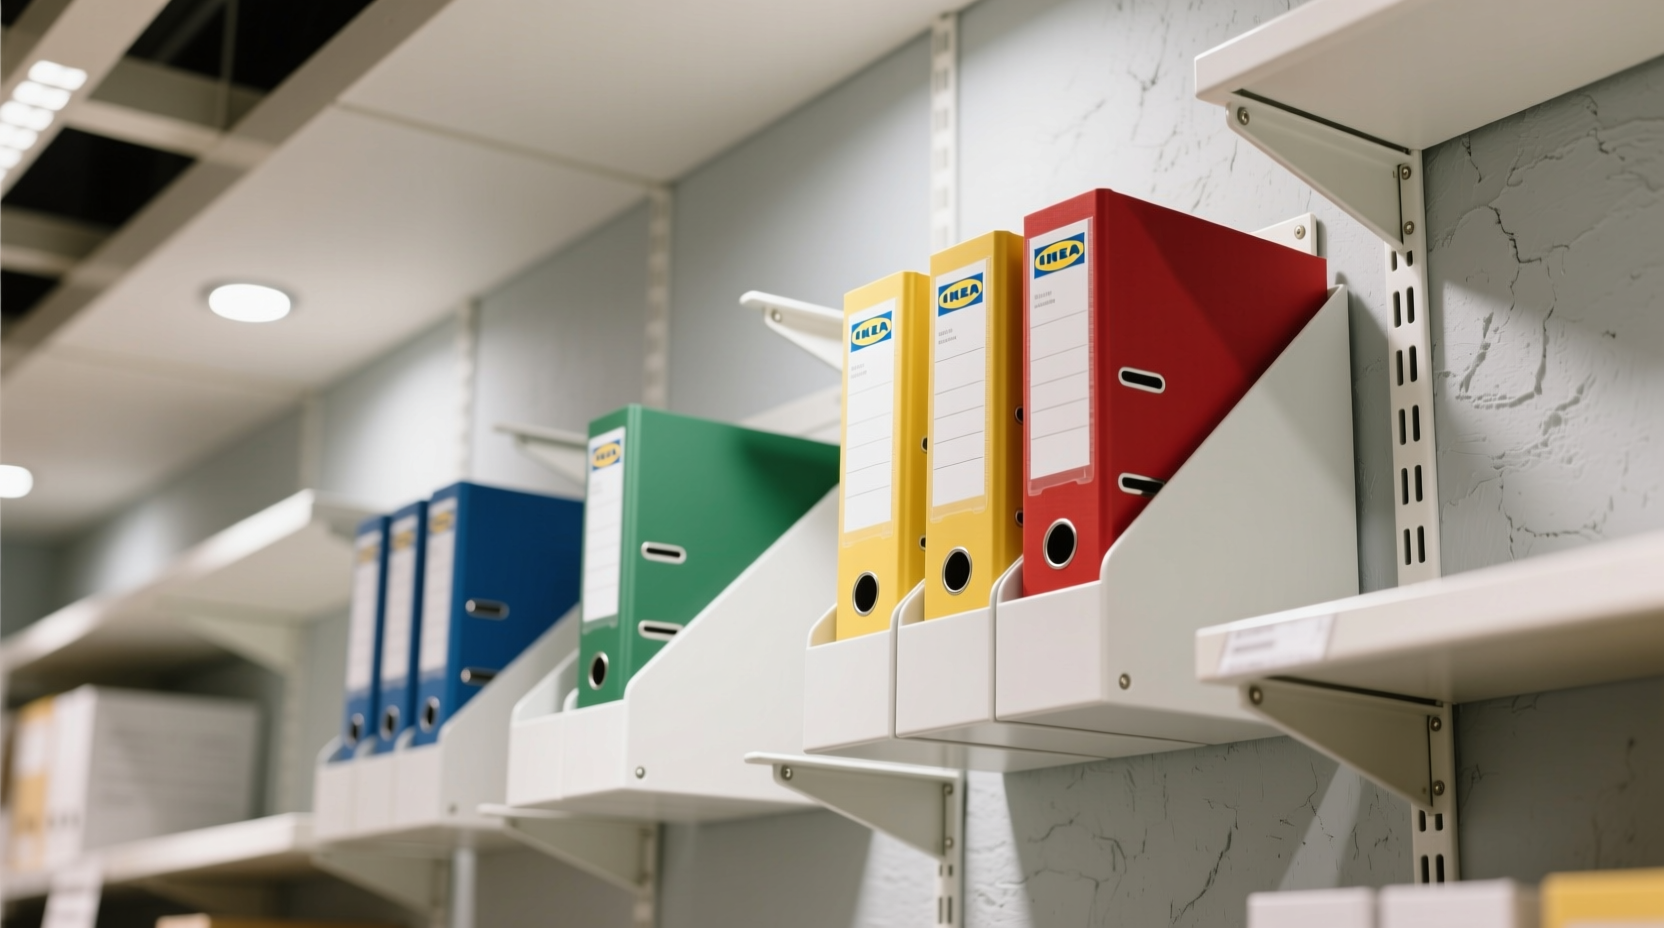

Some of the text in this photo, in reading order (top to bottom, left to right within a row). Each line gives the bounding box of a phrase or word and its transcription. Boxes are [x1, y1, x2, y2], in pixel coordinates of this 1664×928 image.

[1039, 244, 1080, 266] IKEA
[943, 283, 979, 304] IKEA
[855, 321, 888, 341] IKEA
